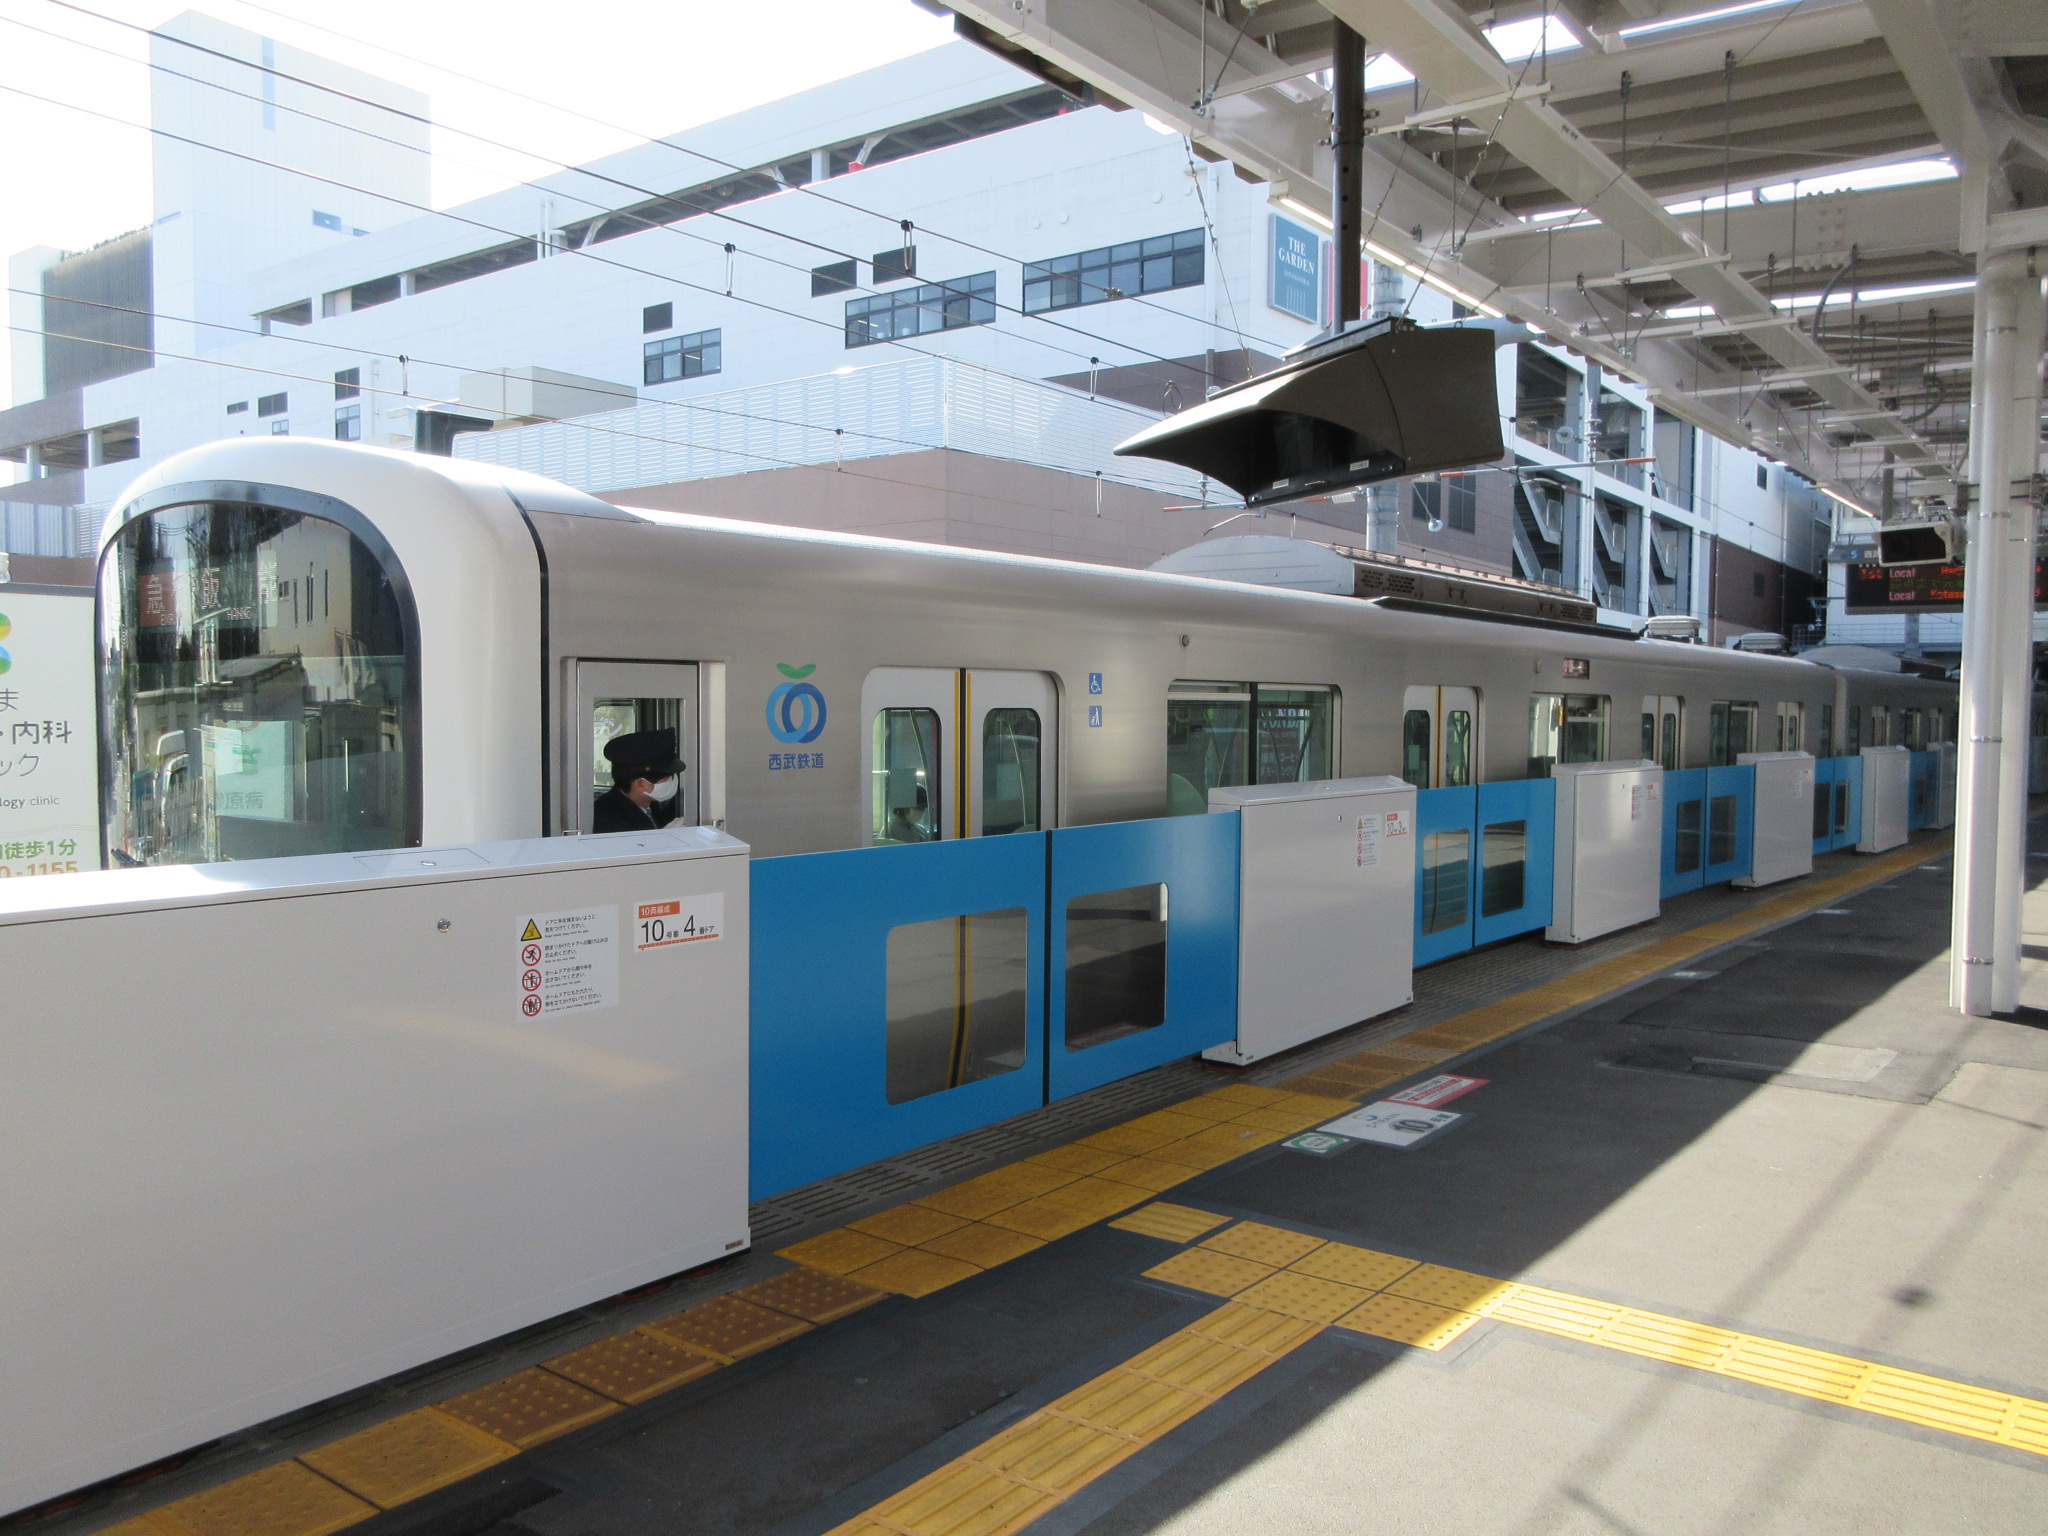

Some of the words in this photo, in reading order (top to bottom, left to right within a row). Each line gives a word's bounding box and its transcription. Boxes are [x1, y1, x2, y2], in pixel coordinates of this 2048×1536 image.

[1288, 236, 1306, 257] THE
[1278, 248, 1315, 275] GARDEN
[1889, 568, 1916, 578] Local
[1889, 591, 1915, 601] Local
[768, 753, 824, 771] 西武鉄道
[30, 796, 60, 806] clinic
[0, 838, 77, 860] 徒歩1分
[641, 905, 671, 916] 10両編成
